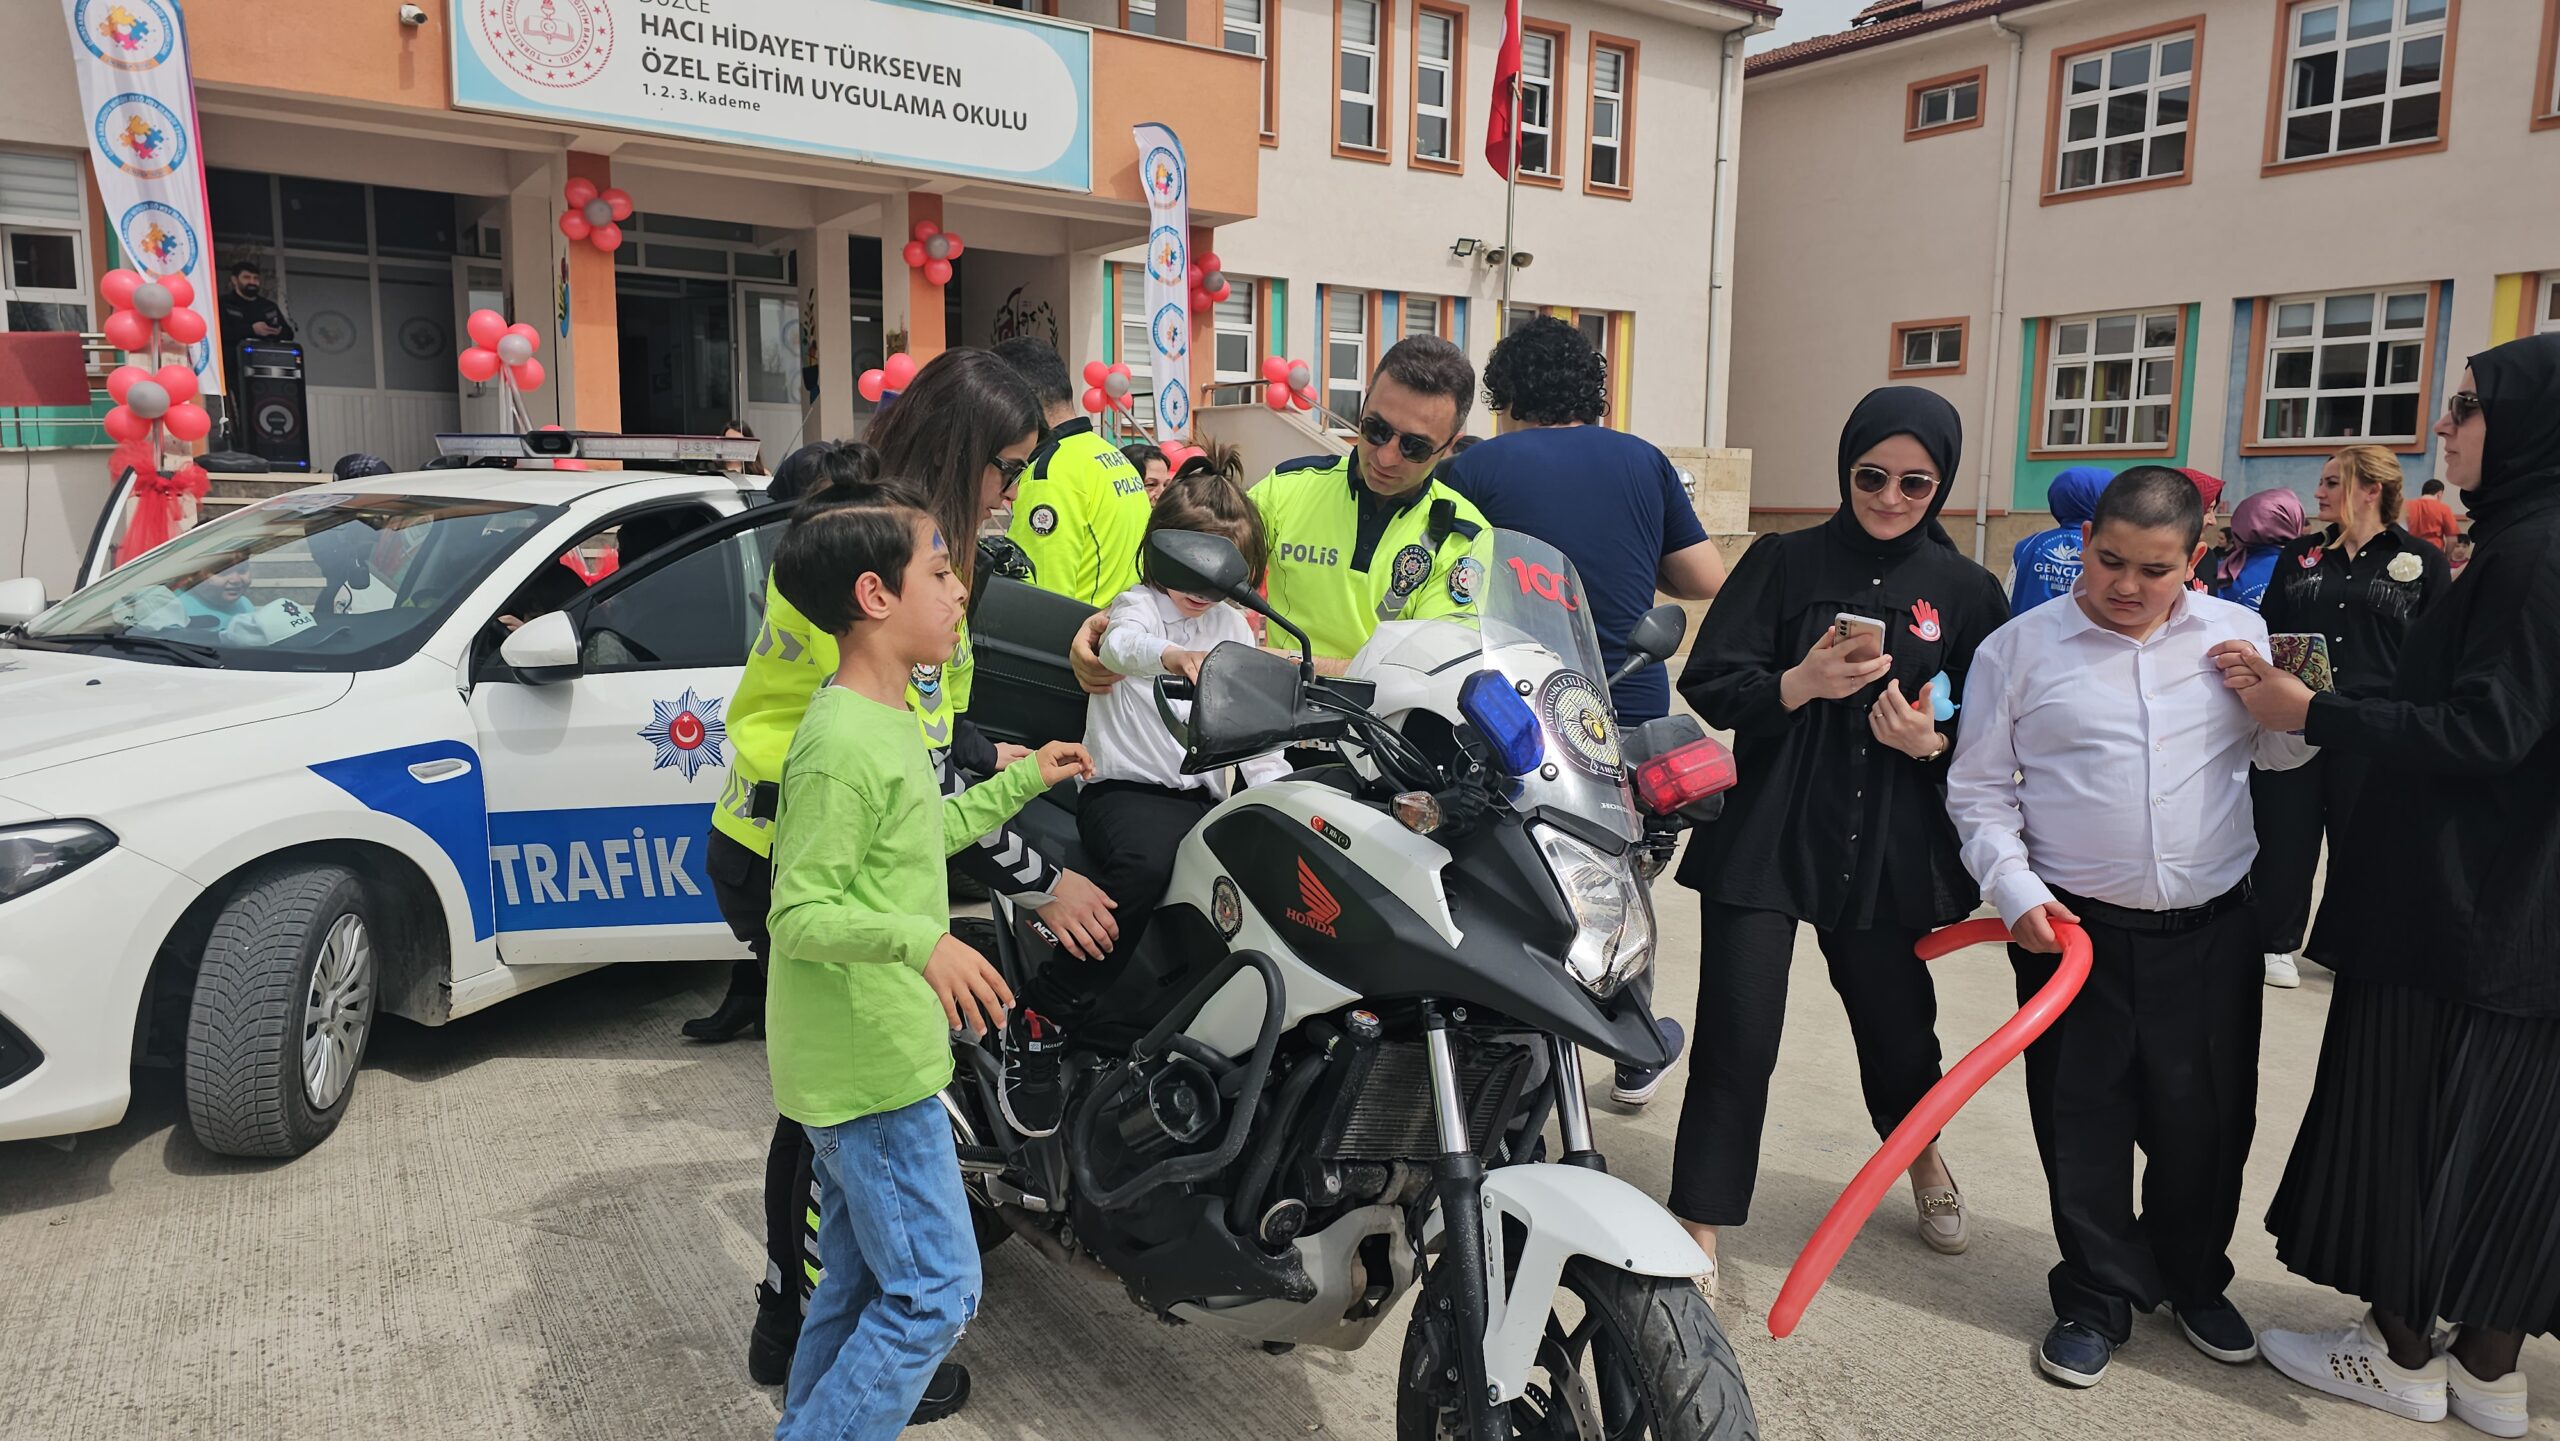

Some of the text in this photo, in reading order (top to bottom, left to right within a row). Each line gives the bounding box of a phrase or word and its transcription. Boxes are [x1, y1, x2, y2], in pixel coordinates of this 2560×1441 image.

[641, 13, 962, 88] HACI HİDAYET TÜRKSEVEN
[641, 46, 1028, 131] ÖZEL EĞİTİM UYGULAMA OKULU
[698, 91, 761, 111] Kademe
[1507, 556, 1579, 612] 100
[2033, 562, 2080, 578] GENÇL
[490, 826, 702, 906] TRAFİK
[1032, 921, 1060, 947] NC7
[1285, 907, 1338, 939] HONDA
